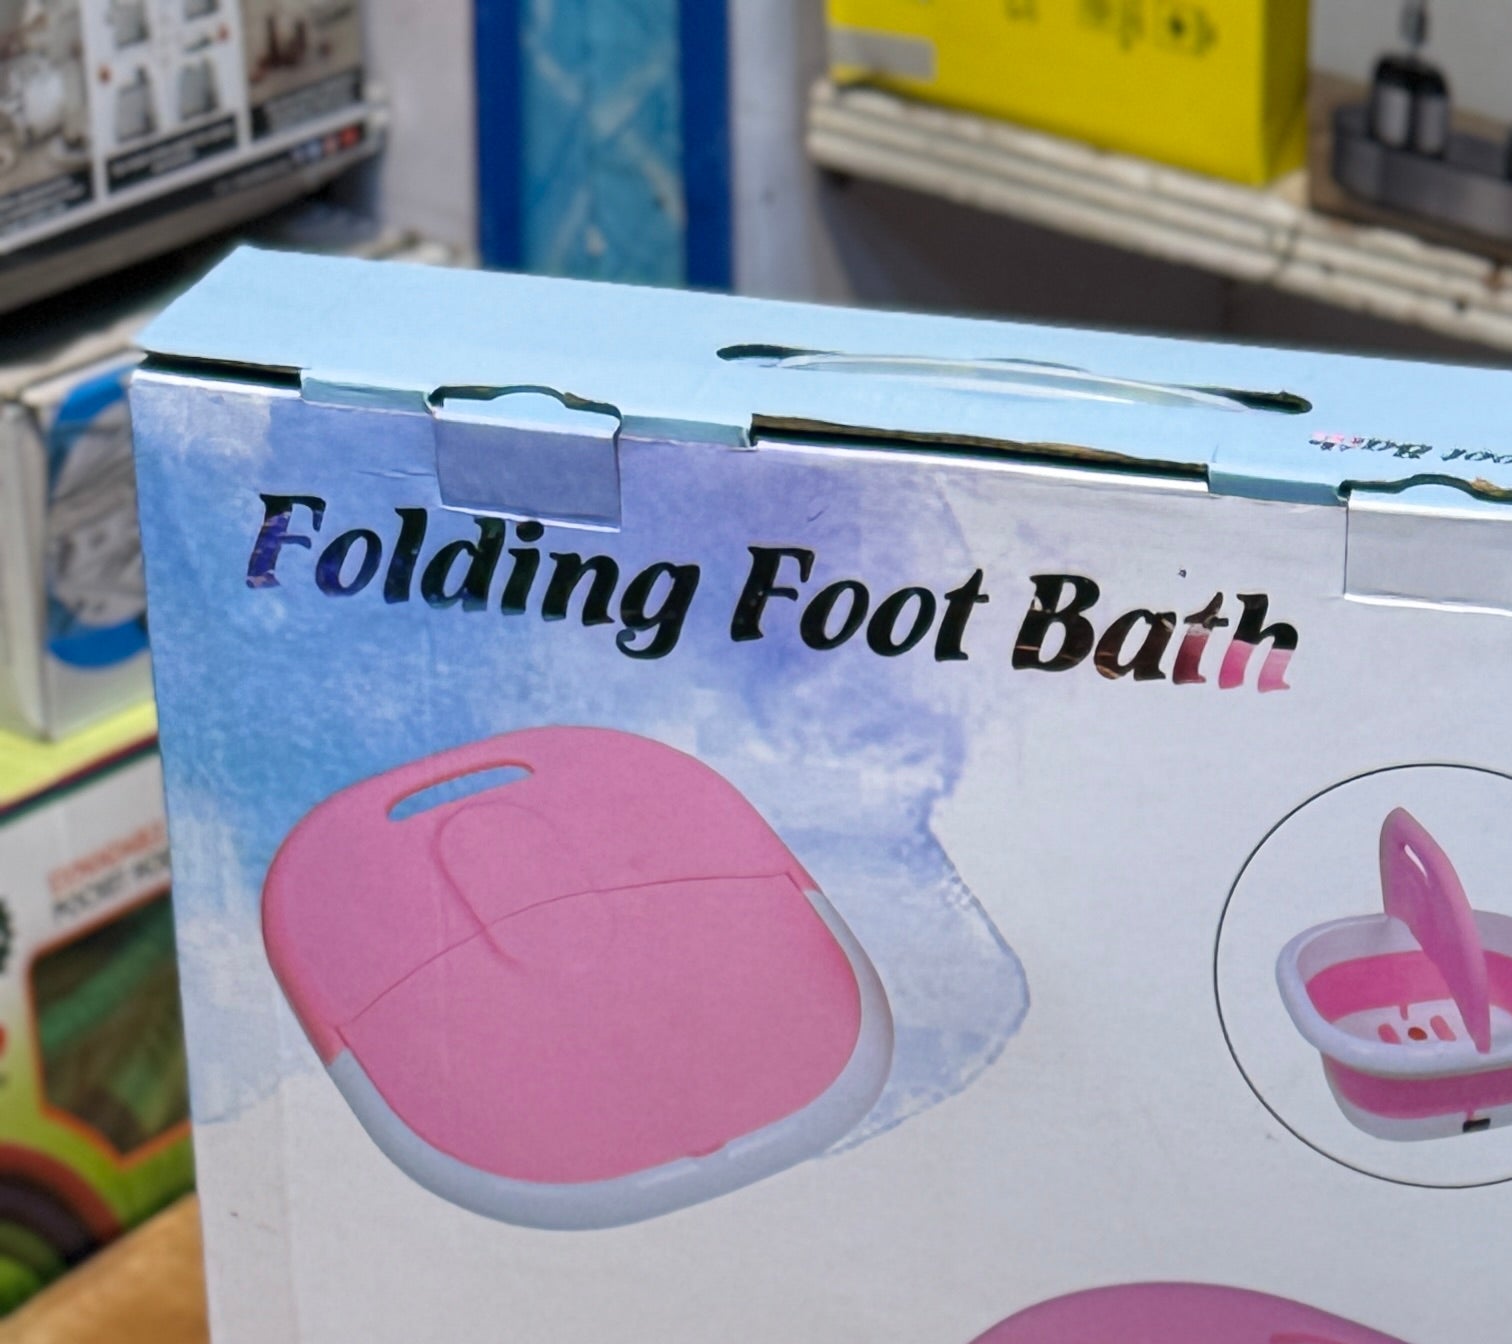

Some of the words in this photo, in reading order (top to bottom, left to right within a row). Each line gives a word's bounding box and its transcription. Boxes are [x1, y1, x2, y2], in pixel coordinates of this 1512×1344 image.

[246, 492, 700, 660] Folding
[730, 545, 989, 661] Foot
[1011, 572, 1300, 693] Bath
